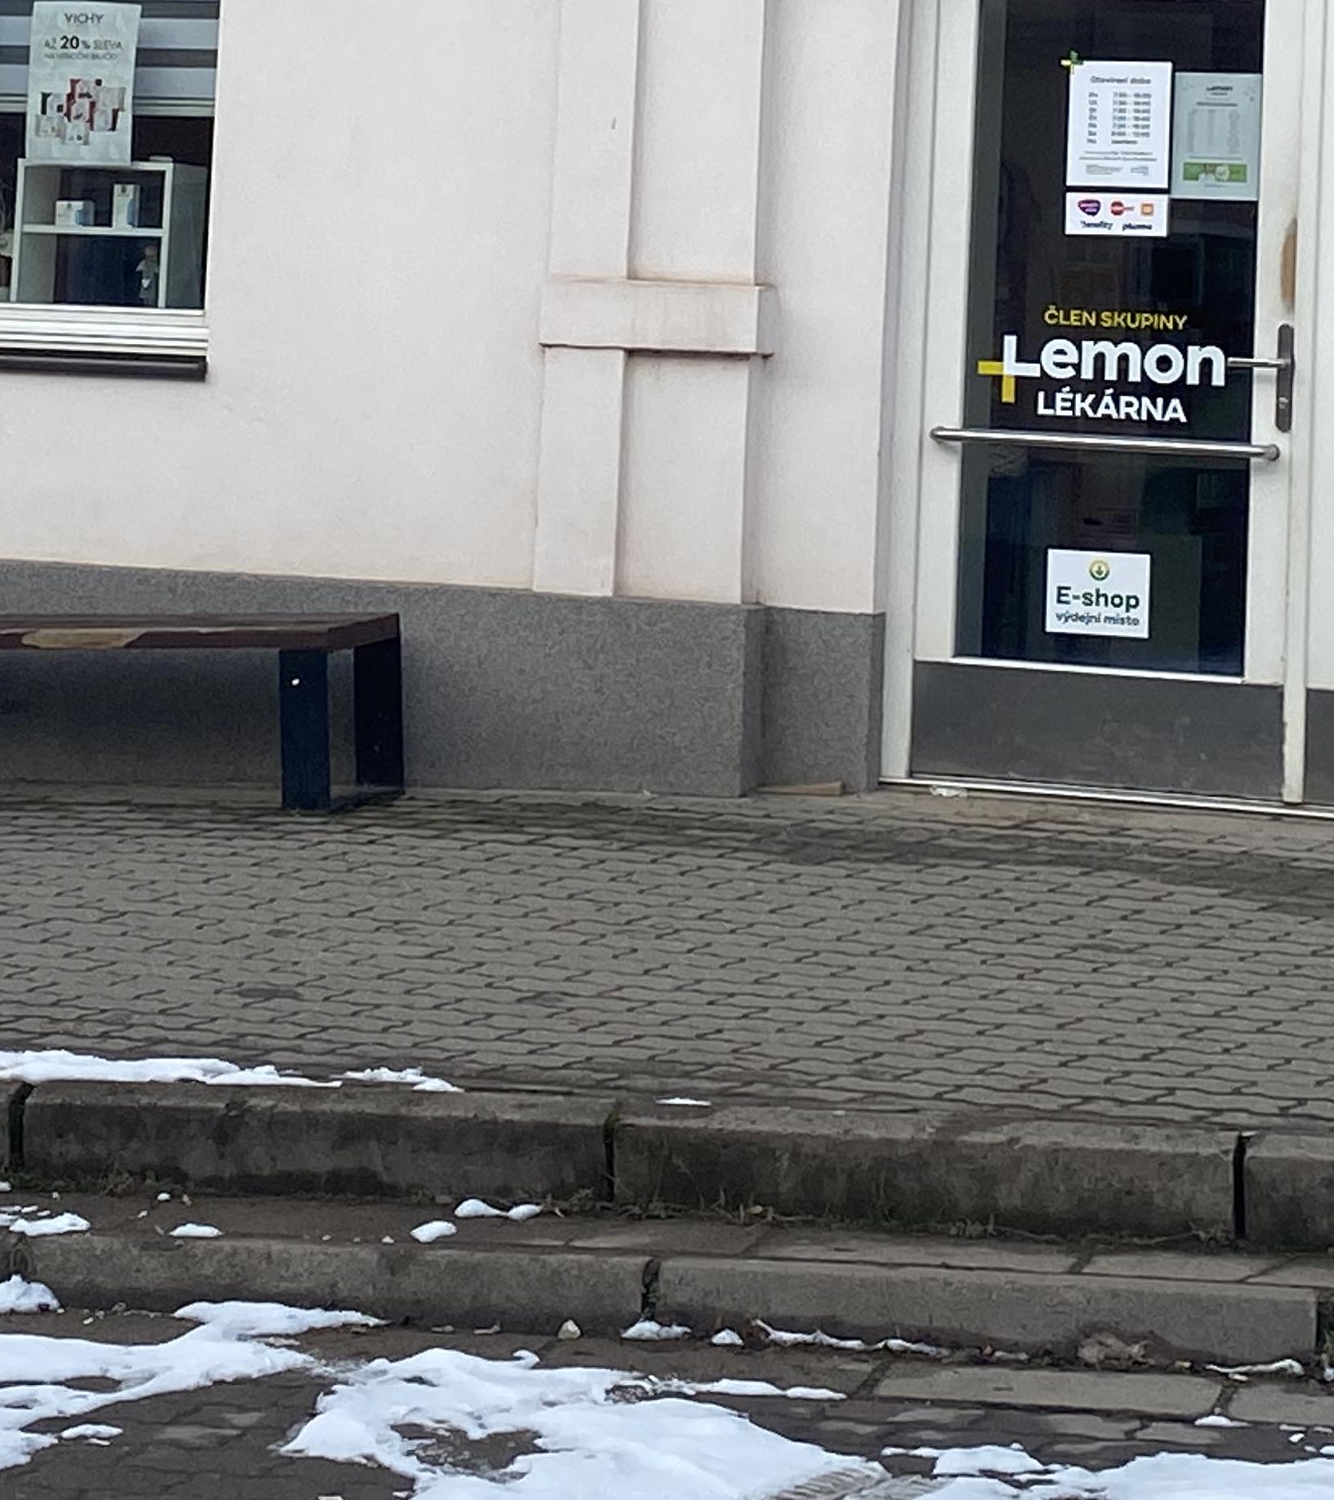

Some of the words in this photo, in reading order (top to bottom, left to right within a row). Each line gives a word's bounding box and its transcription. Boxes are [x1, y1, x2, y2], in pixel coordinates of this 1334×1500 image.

[64, 13, 104, 25] VICHY
[60, 35, 80, 50] 20
[1043, 305, 1097, 327] ČLEN
[1100, 310, 1188, 331] SKUPINY
[1003, 334, 1226, 387] Lemon
[1036, 386, 1188, 423] LÉKÁRNA
[1056, 585, 1140, 613] E-shop
[1103, 613, 1140, 627] místo
